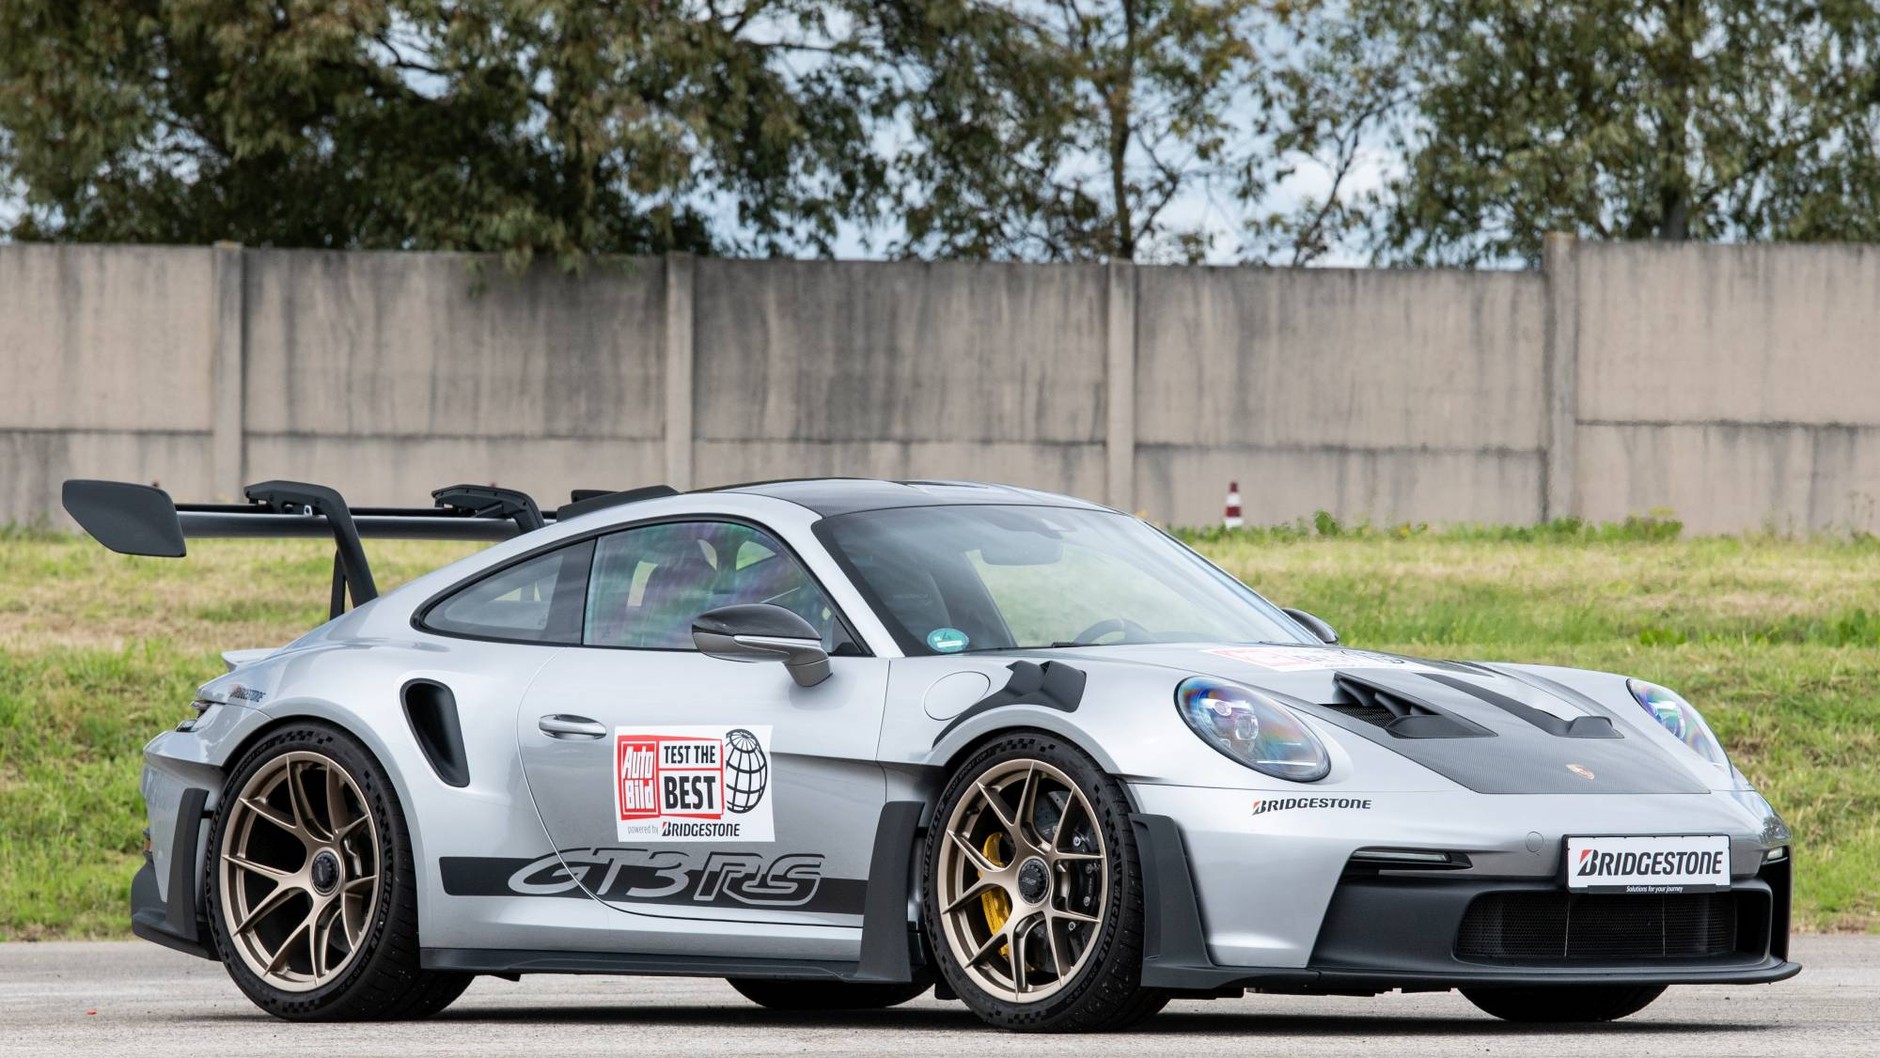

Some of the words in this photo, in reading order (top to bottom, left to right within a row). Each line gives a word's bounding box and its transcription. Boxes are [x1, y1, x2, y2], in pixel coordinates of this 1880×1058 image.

[622, 745, 655, 780] Auto
[664, 745, 691, 764] TEST
[694, 745, 716, 764] THE
[624, 778, 656, 810] Bild
[664, 776, 716, 810] BEST
[1252, 798, 1372, 816] BRIDGESTONE
[628, 826, 652, 835] powered
[653, 825, 659, 836] by
[662, 821, 741, 837] BRIDGESTONE
[1576, 849, 1724, 877] BRIDGESTONE
